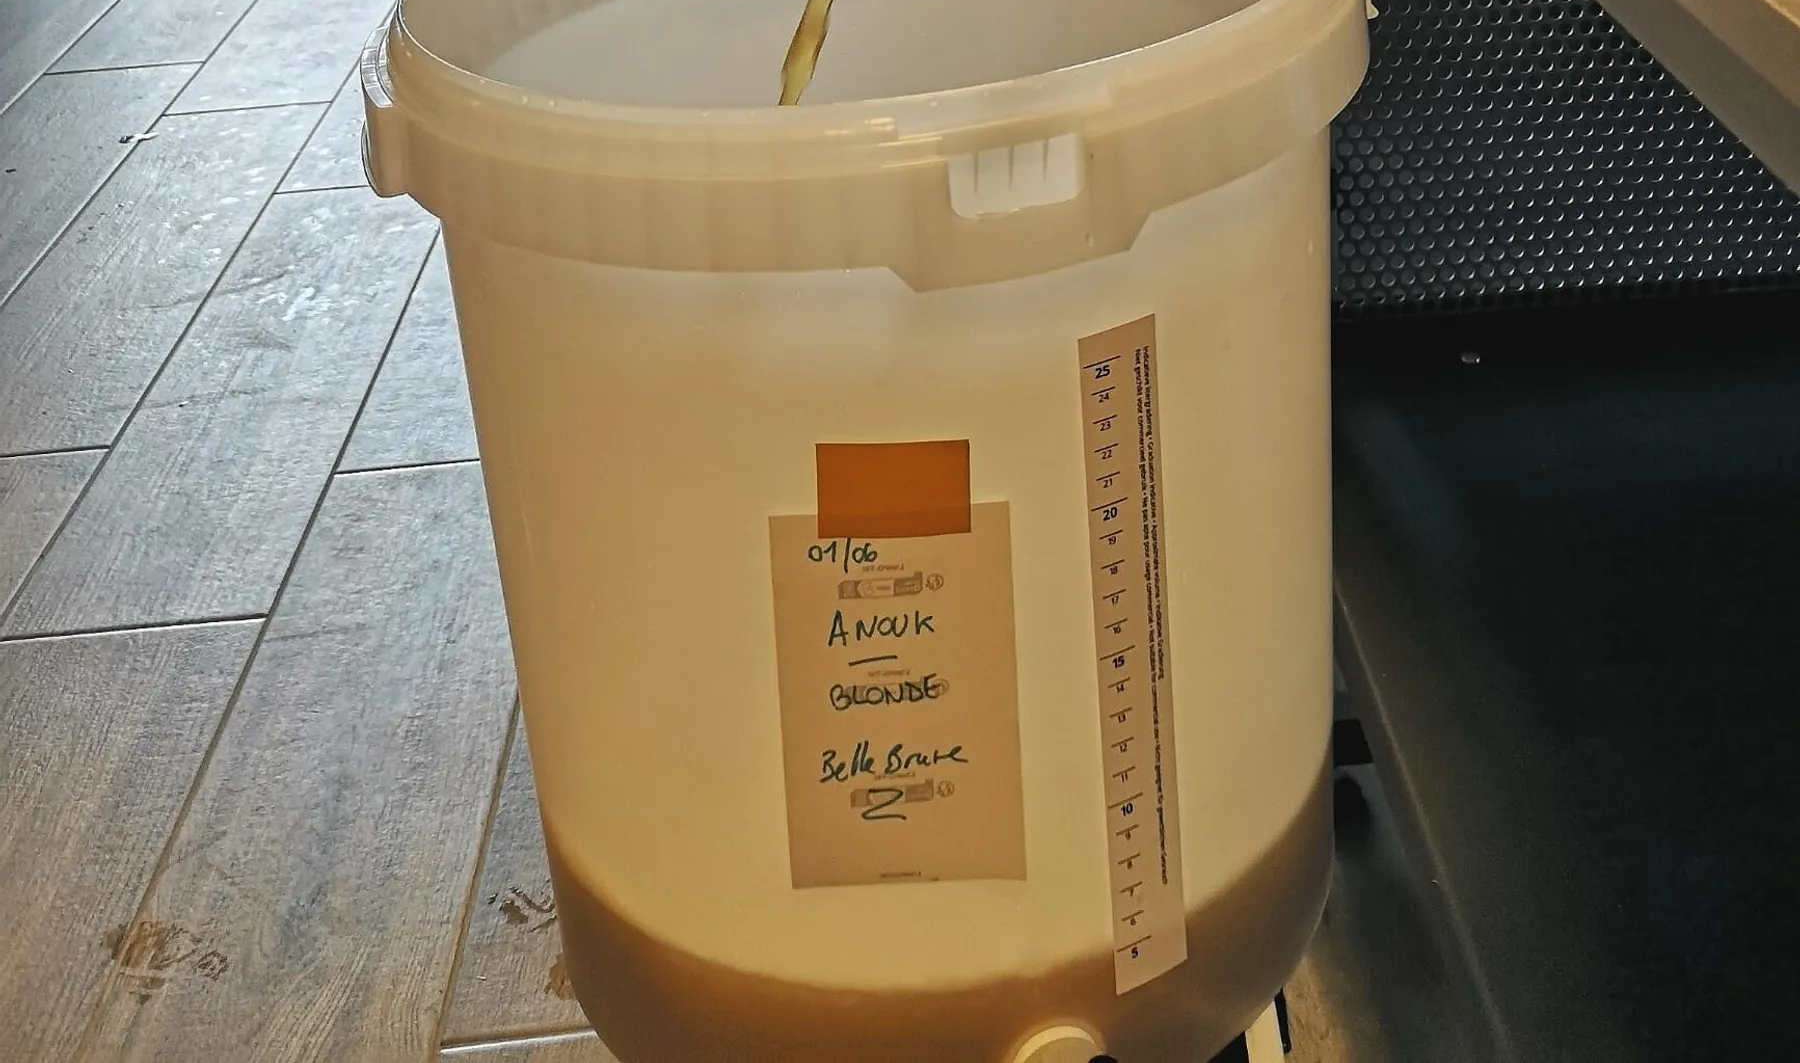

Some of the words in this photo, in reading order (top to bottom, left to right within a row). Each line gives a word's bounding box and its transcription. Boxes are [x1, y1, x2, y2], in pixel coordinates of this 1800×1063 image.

[1095, 365, 1110, 379] 25
[1098, 393, 1110, 404] 24
[1100, 421, 1111, 432] 23
[1101, 449, 1113, 460] 22
[1103, 478, 1113, 489] 21
[1103, 507, 1118, 521] 20
[1108, 537, 1117, 546] 19
[808, 537, 878, 573] 01/06
[1110, 566, 1118, 575] 18
[1111, 595, 1119, 606] 17
[828, 610, 936, 647] ANOUK
[1112, 655, 1125, 668] 15
[829, 673, 940, 711] BLONDE
[1116, 684, 1125, 693] 14
[1119, 743, 1128, 753] 12
[819, 740, 876, 783] Belle
[1120, 772, 1128, 782] 11
[1121, 803, 1134, 817] 10
[1131, 946, 1139, 959] 5
